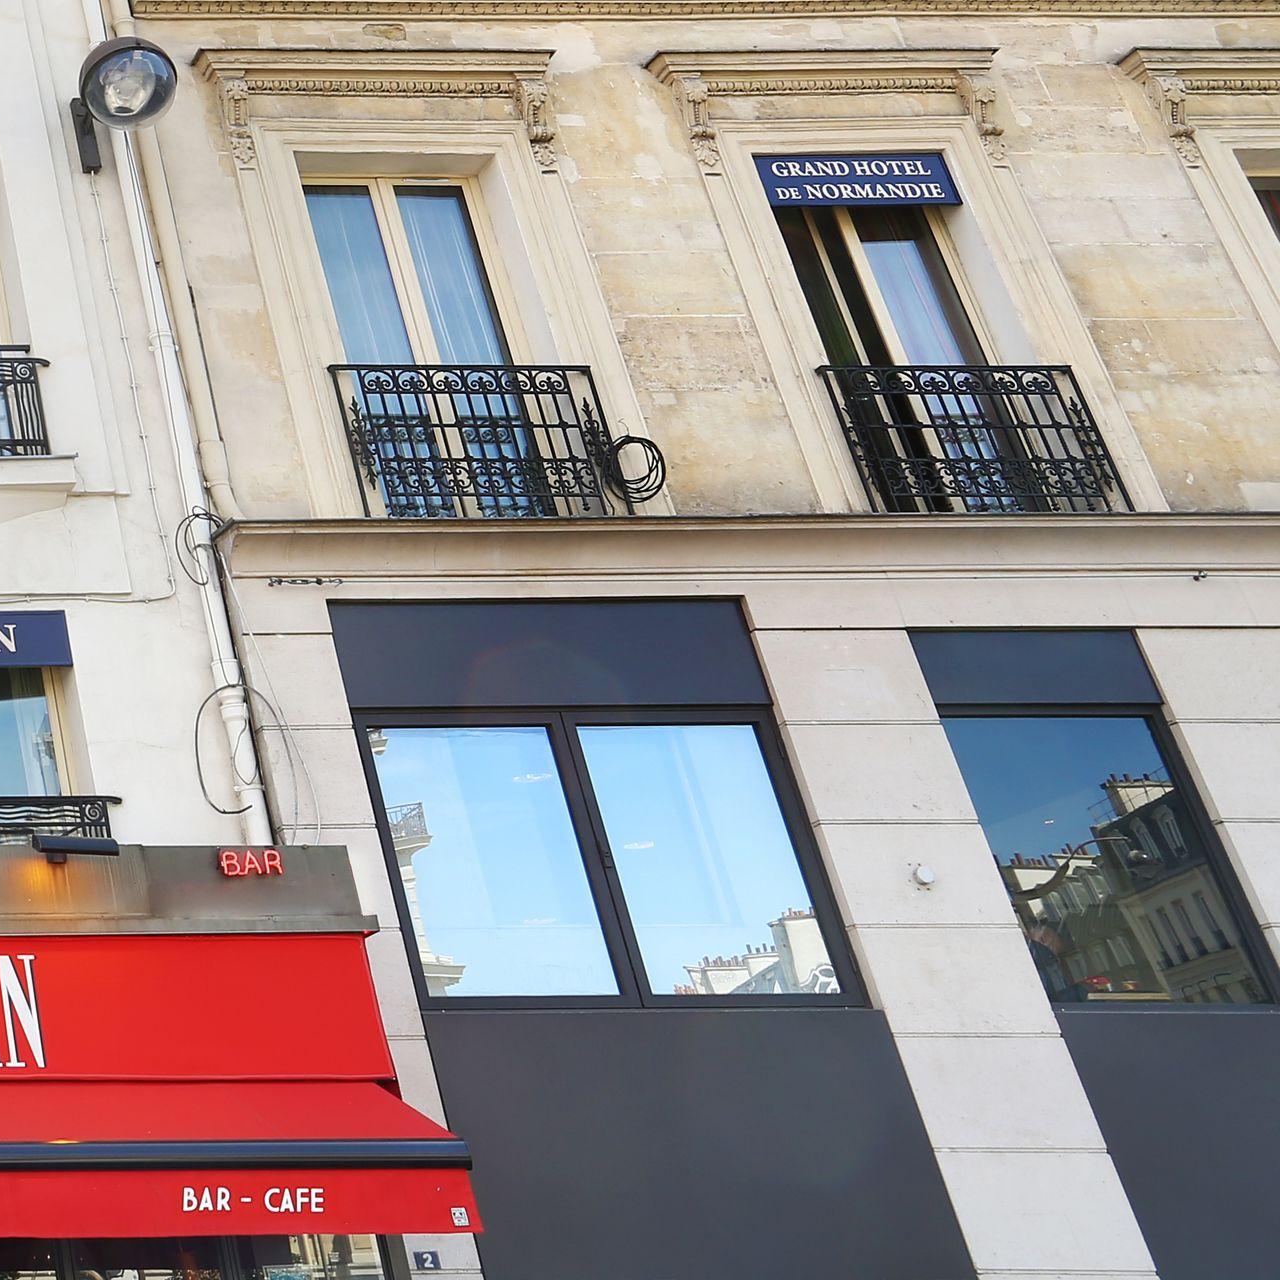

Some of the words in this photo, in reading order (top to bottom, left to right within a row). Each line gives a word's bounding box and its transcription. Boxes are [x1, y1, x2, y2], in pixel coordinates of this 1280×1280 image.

[771, 162, 850, 177] GRAND
[851, 160, 932, 176] HOTEL
[775, 187, 802, 200] DE
[802, 183, 945, 200] NORMANDIE
[221, 850, 282, 875] BAR
[182, 1187, 231, 1212] BAR
[264, 1188, 324, 1213] CAFE
[422, 1253, 435, 1268] 2
